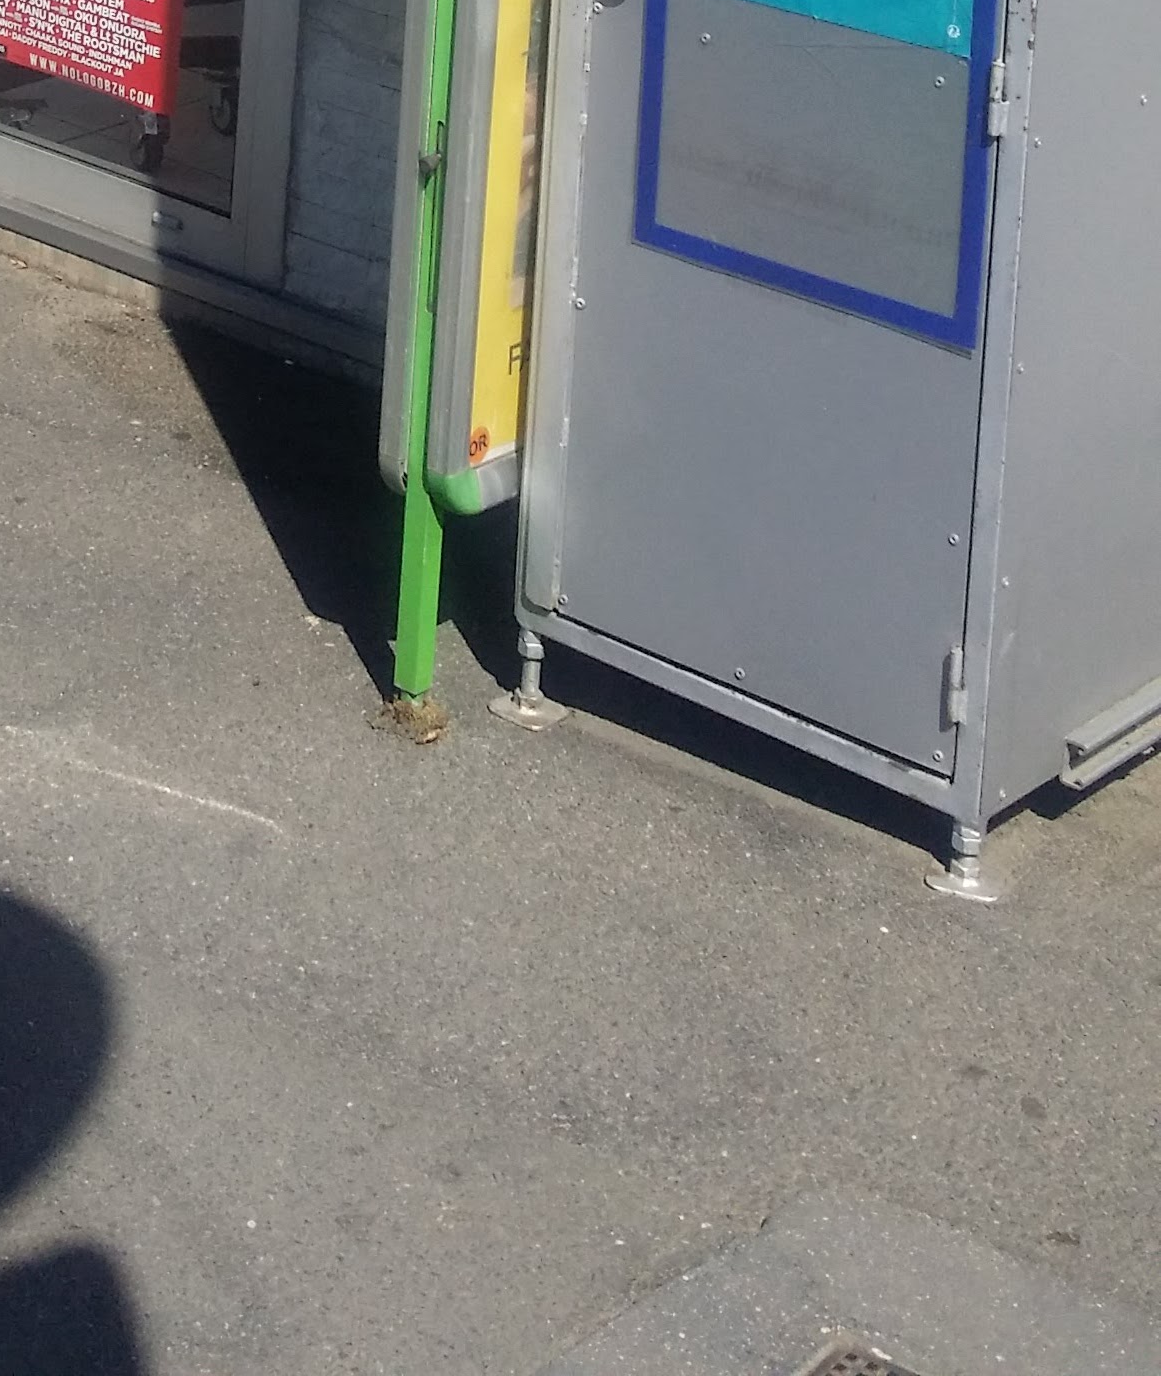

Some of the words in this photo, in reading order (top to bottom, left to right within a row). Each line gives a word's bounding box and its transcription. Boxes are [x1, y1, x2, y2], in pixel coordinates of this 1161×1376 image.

[16, 1, 47, 21] MANU
[47, 12, 89, 35] DIGITAL
[112, 33, 162, 58] STITCHIE
[58, 37, 85, 54] SOUND
[60, 26, 82, 41] THE
[83, 36, 145, 65] ROOTSMAN
[74, 10, 97, 26] OKU
[99, 17, 147, 43] ONUORA
[11, 30, 38, 48] DADDY
[38, 40, 68, 58] FREDDY
[70, 51, 113, 74] BLACKOUT
[29, 53, 155, 109] WWW.NOLOGOBZH.COM
